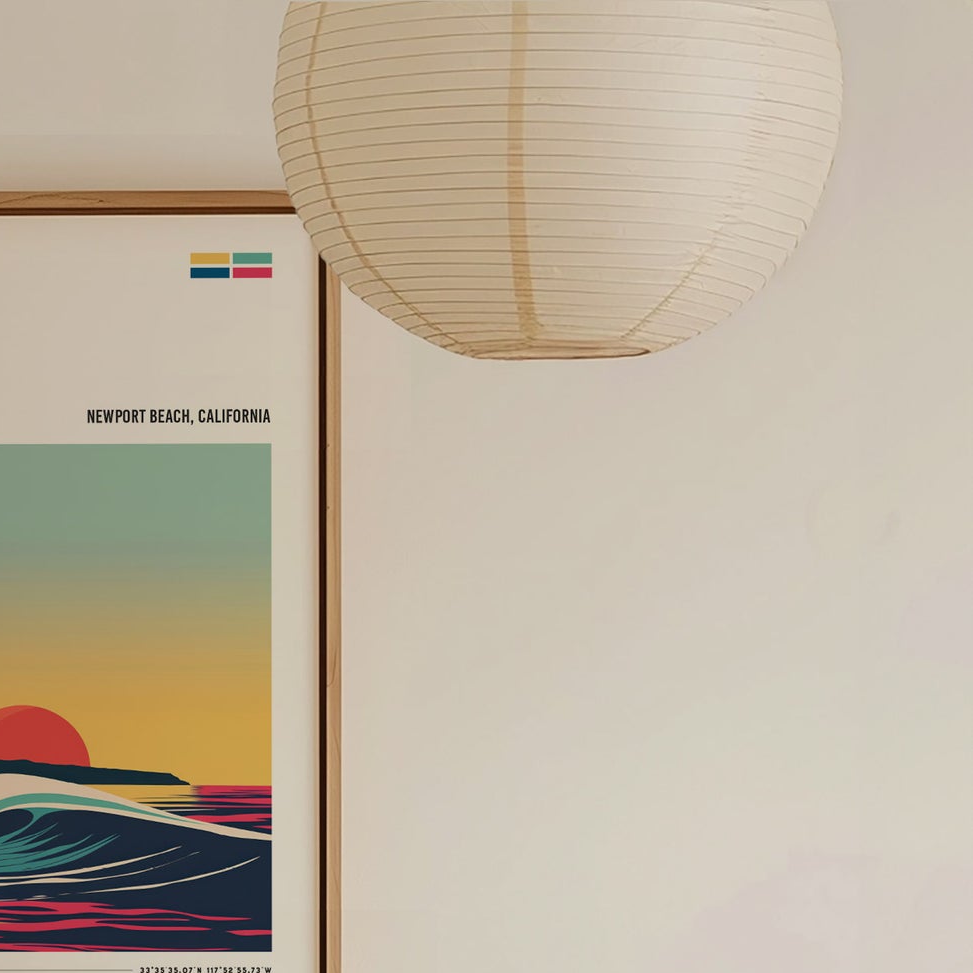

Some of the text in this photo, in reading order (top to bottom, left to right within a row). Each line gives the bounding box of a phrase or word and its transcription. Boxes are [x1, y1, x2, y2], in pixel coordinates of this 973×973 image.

[86, 409, 271, 425] NEWPORT BEACH, CALIFORNIA
